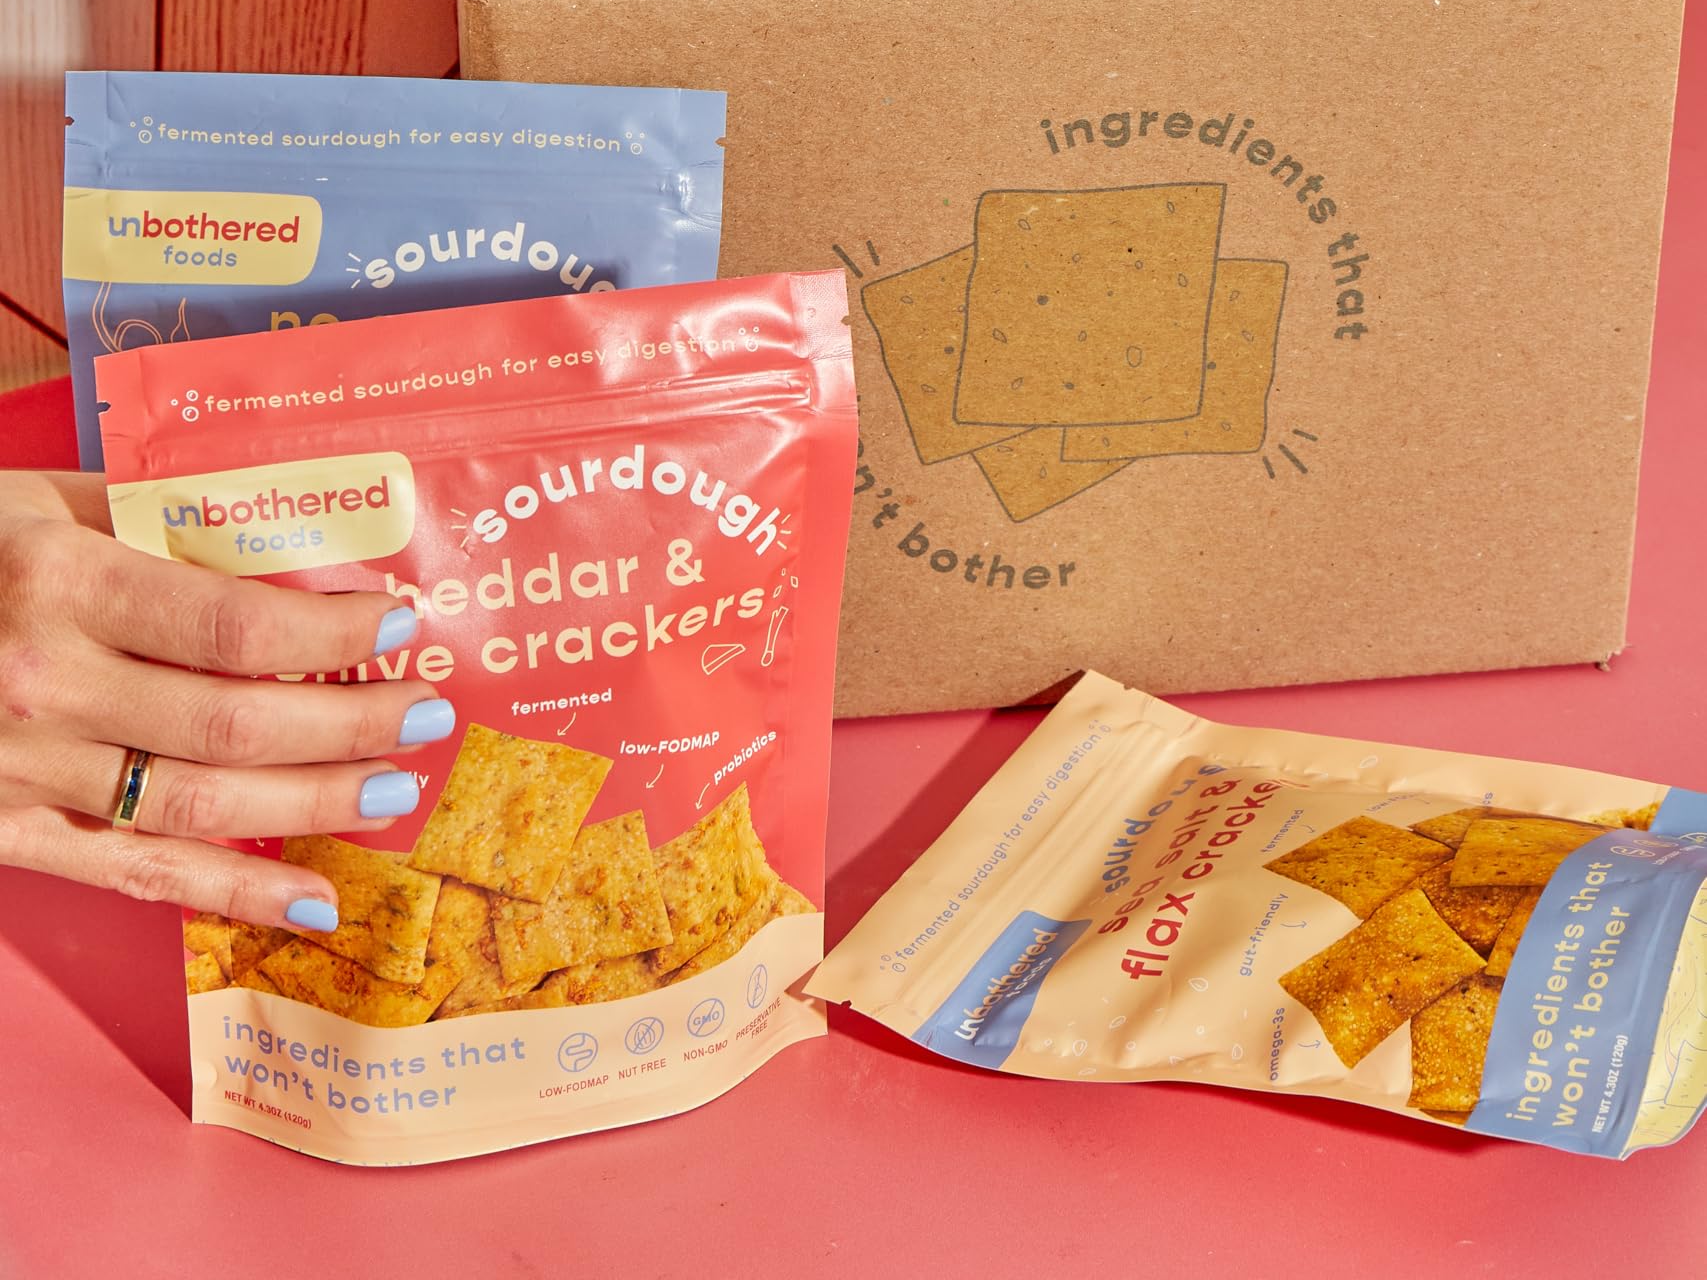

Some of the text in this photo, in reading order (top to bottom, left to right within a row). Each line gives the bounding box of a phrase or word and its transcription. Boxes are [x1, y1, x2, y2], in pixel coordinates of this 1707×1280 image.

[158, 124, 622, 153] fermented sourdough for easy digestion
[107, 210, 301, 245] unbothered
[1041, 109, 1370, 342] ingredients that
[162, 246, 238, 268] foods
[204, 335, 736, 414] fermented sourdough for easy digestion
[162, 475, 391, 528] unbothered
[472, 444, 781, 557] sourdough
[234, 527, 324, 555] foods
[896, 522, 1077, 590] bother
[384, 538, 706, 620] heddar &
[480, 588, 766, 674] crackers
[511, 688, 613, 716] fermented
[619, 731, 720, 755] low-FODMAP
[713, 730, 777, 786] probiotics
[895, 733, 1102, 961] fermented sourdough for easy digestion
[1097, 778, 1243, 937] sea salt &
[1120, 779, 1286, 981] flax cracke
[1239, 892, 1289, 977] gut-friendly
[953, 926, 1059, 1041] unbothered
[1504, 861, 1614, 1121] ingredients that
[735, 996, 782, 1041] PRESERVATIVE
[750, 1019, 769, 1040] FREE
[1269, 1006, 1286, 1082] omega-3s
[1551, 905, 1632, 1127] won't bother
[221, 1015, 526, 1081] ingredients that
[618, 1057, 667, 1080] NUT FREE
[683, 1039, 729, 1062] NON-GMO
[1610, 1033, 1629, 1068] (120g)
[224, 1055, 457, 1115] won't bother
[224, 1090, 243, 1102] NET
[243, 1095, 257, 1109] WT
[284, 1111, 312, 1130] (120g)
[539, 1075, 609, 1099] LOW-FODMAP
[1599, 1099, 1612, 1115] WT
[1592, 1114, 1607, 1133] NET
